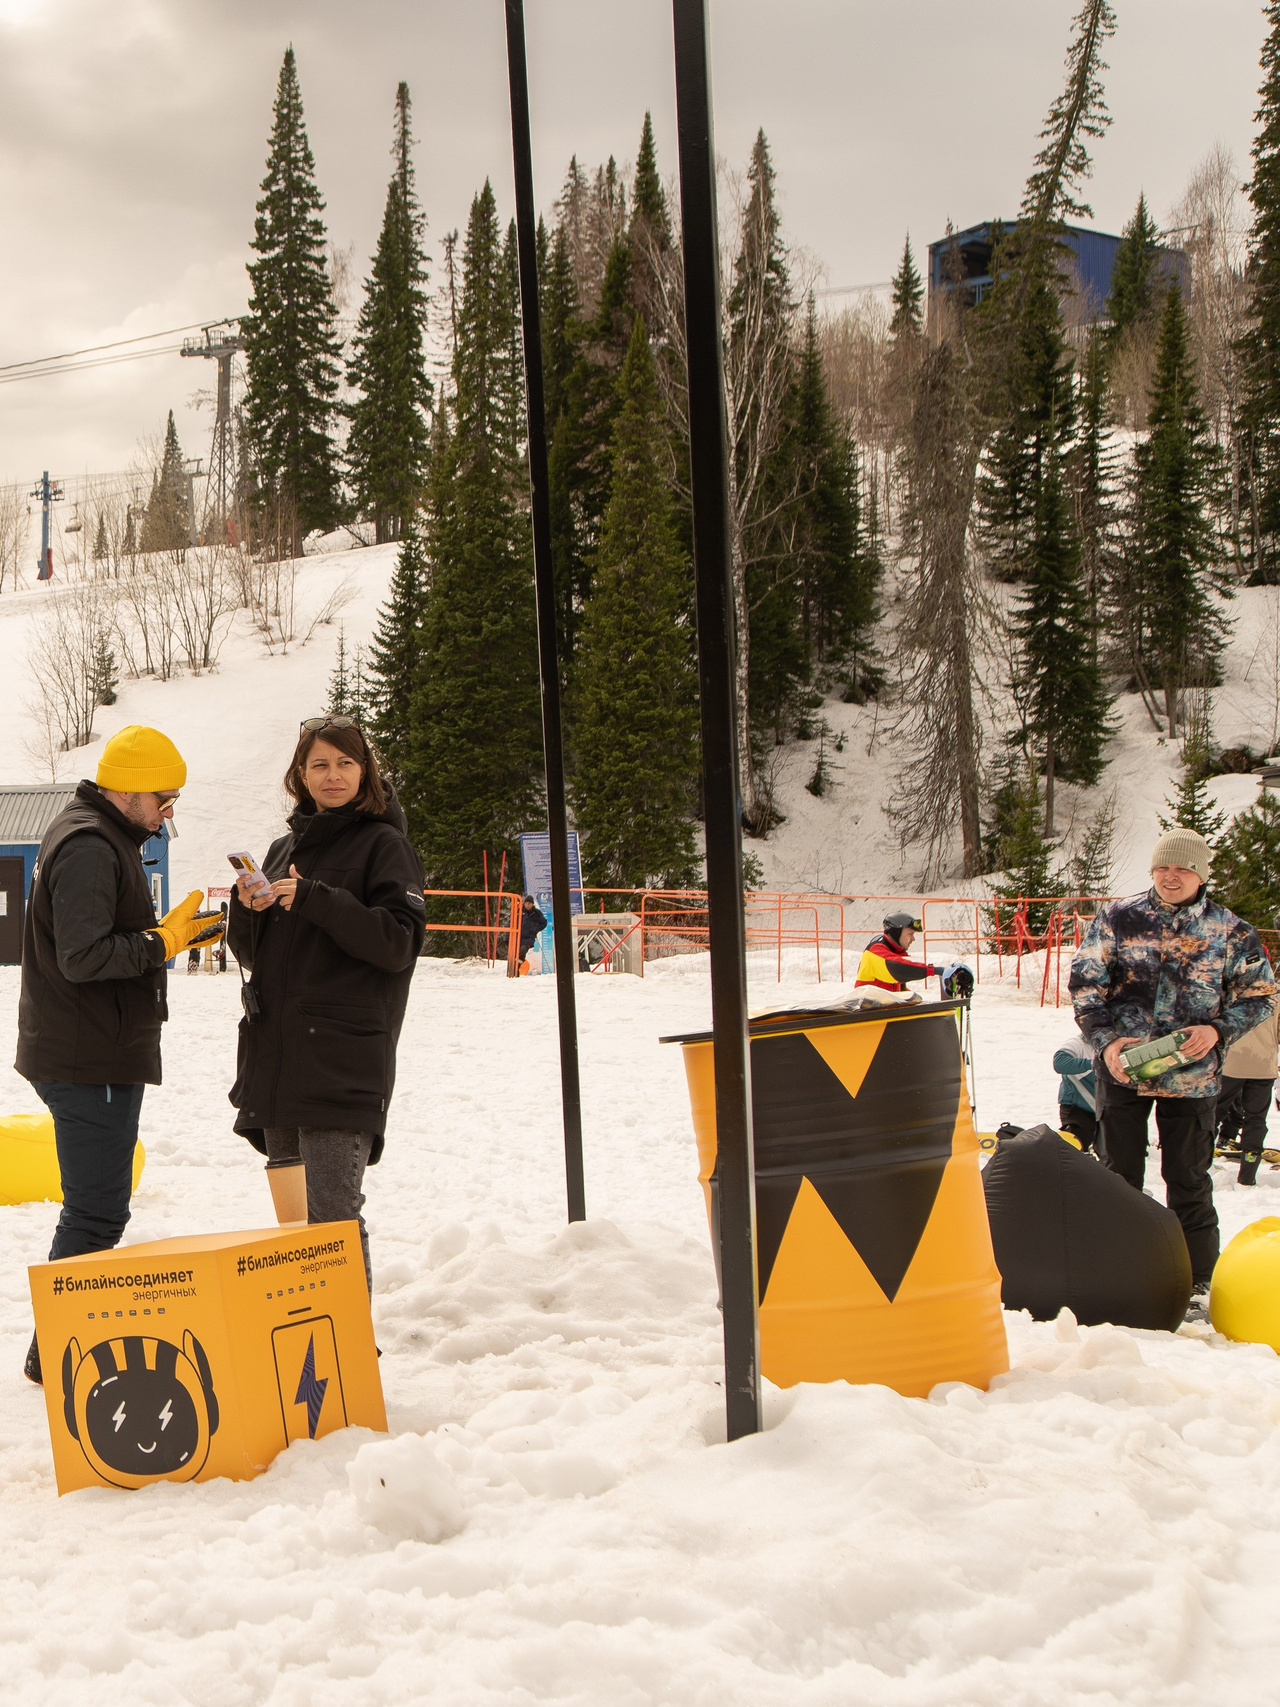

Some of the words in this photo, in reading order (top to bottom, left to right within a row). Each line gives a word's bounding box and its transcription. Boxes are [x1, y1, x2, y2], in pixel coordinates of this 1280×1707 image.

[237, 1240, 345, 1277] #билайнсоединяет
[300, 1256, 348, 1274] энергичных
[53, 1270, 194, 1296] #билайнсоединяет
[132, 1287, 198, 1302] энергичных
